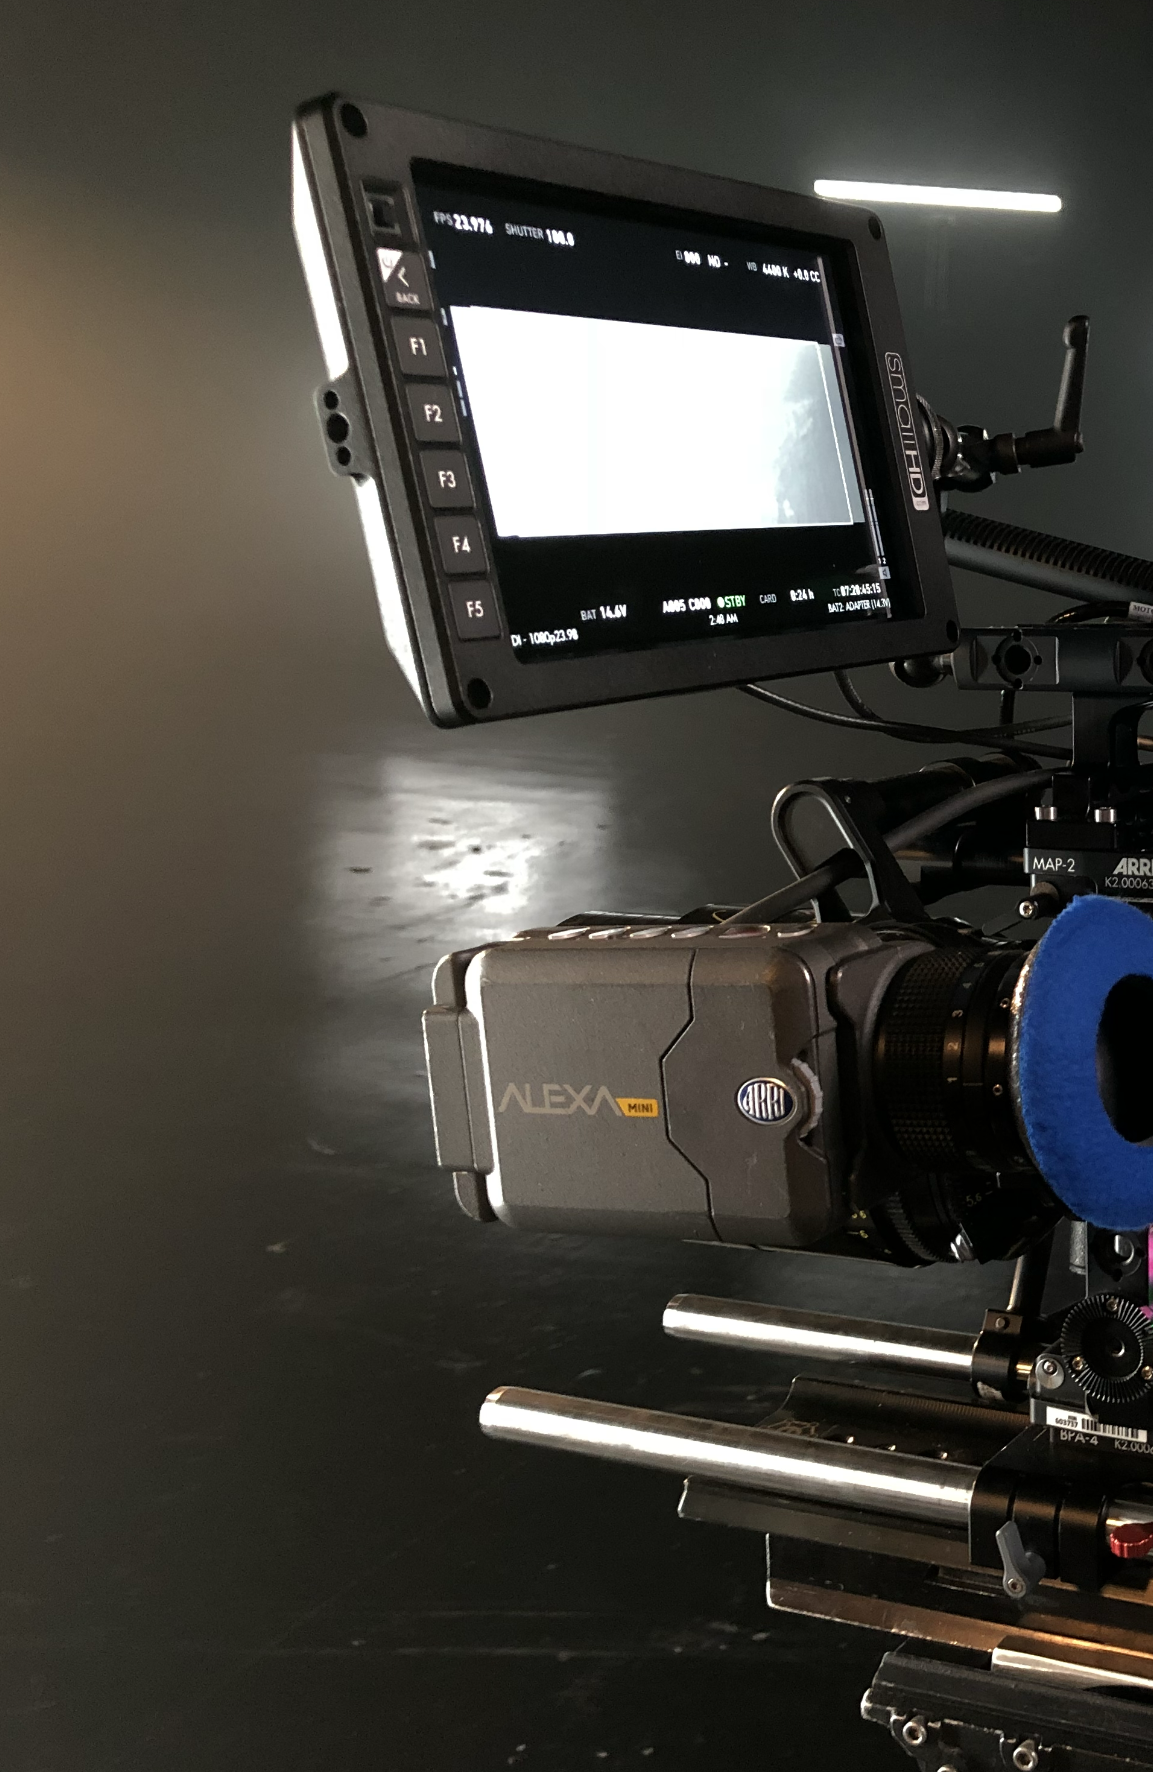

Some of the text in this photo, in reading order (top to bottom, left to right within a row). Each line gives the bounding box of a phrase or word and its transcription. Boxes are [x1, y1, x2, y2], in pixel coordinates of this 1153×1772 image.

[433, 211, 453, 226] FPS
[504, 223, 544, 239] SHUTTER
[746, 261, 757, 271] WB
[396, 292, 420, 305] BACK
[409, 336, 427, 356] F1
[423, 403, 443, 422] F2
[437, 470, 456, 488] F3
[452, 535, 471, 553] F4
[725, 594, 746, 609] STBY
[759, 593, 777, 605] CARD
[466, 600, 484, 618] F5
[580, 609, 596, 621] BAT
[1032, 856, 1075, 873] MAP-2
[498, 1082, 653, 1117] ALEXA MINI
[741, 1081, 787, 1120] ARRI
